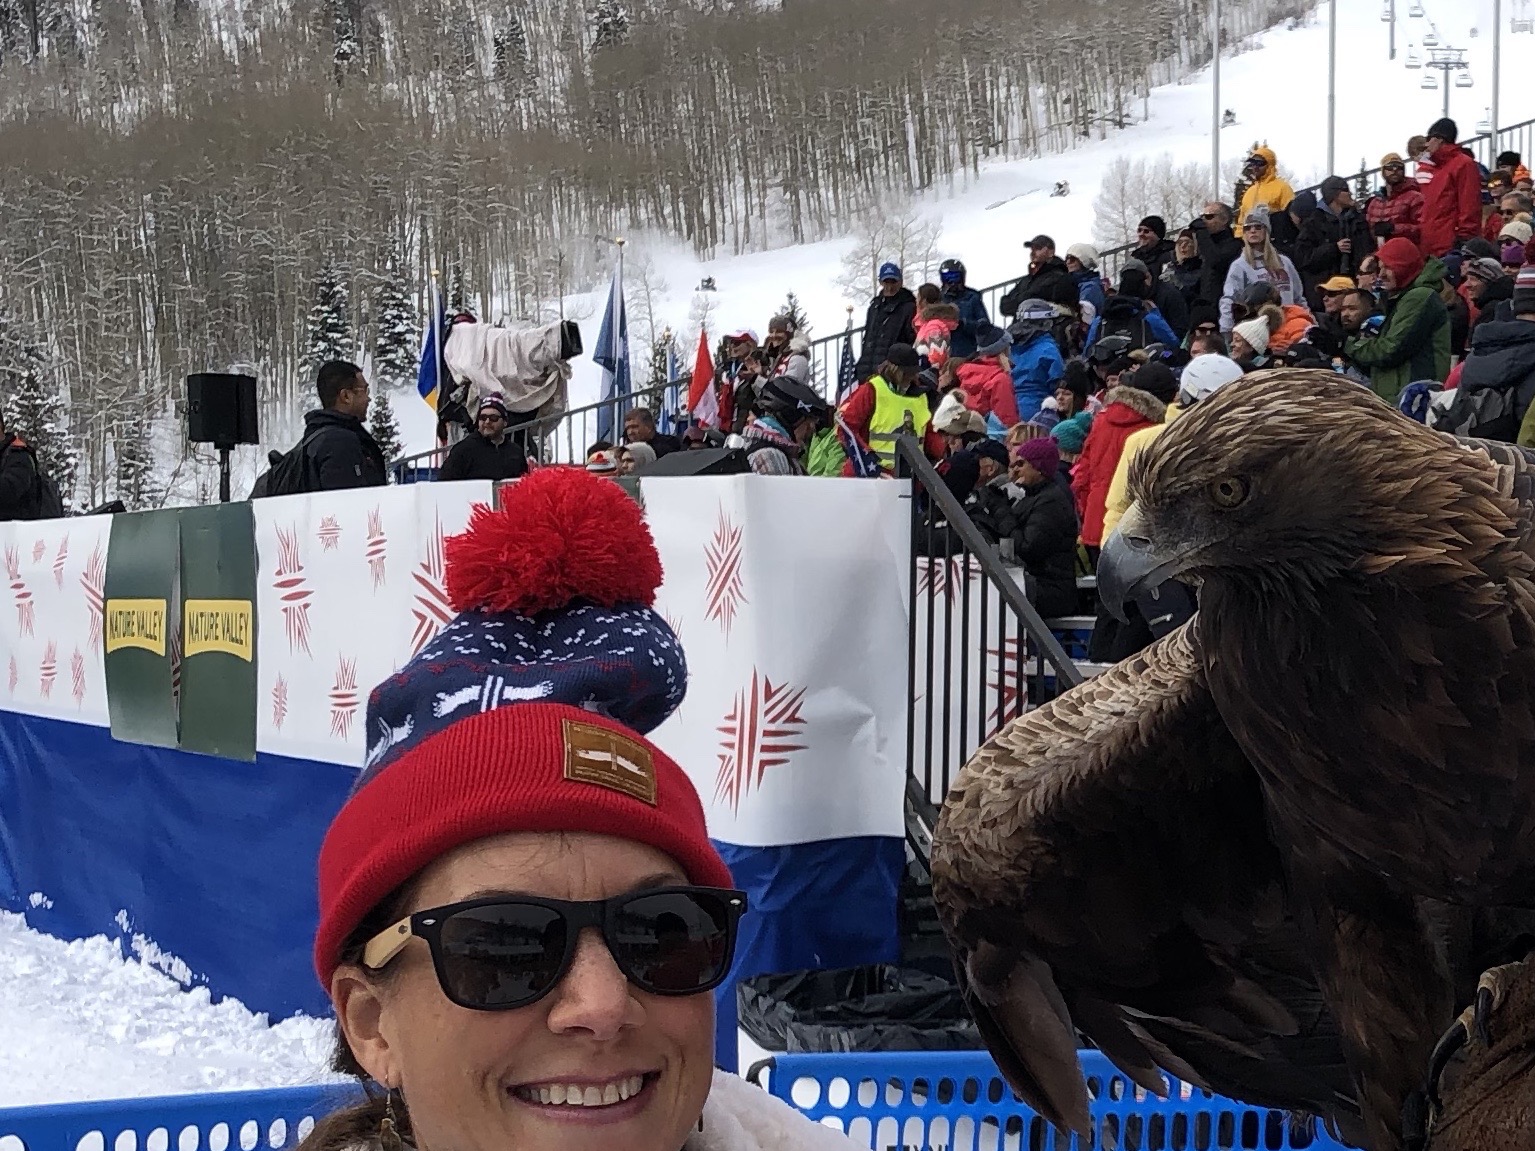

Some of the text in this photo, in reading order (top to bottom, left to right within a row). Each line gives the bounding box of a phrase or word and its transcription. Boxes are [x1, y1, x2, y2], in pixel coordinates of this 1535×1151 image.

[109, 610, 164, 643] NATURE VALLEY
[188, 611, 250, 648] NATURE VALLEY
